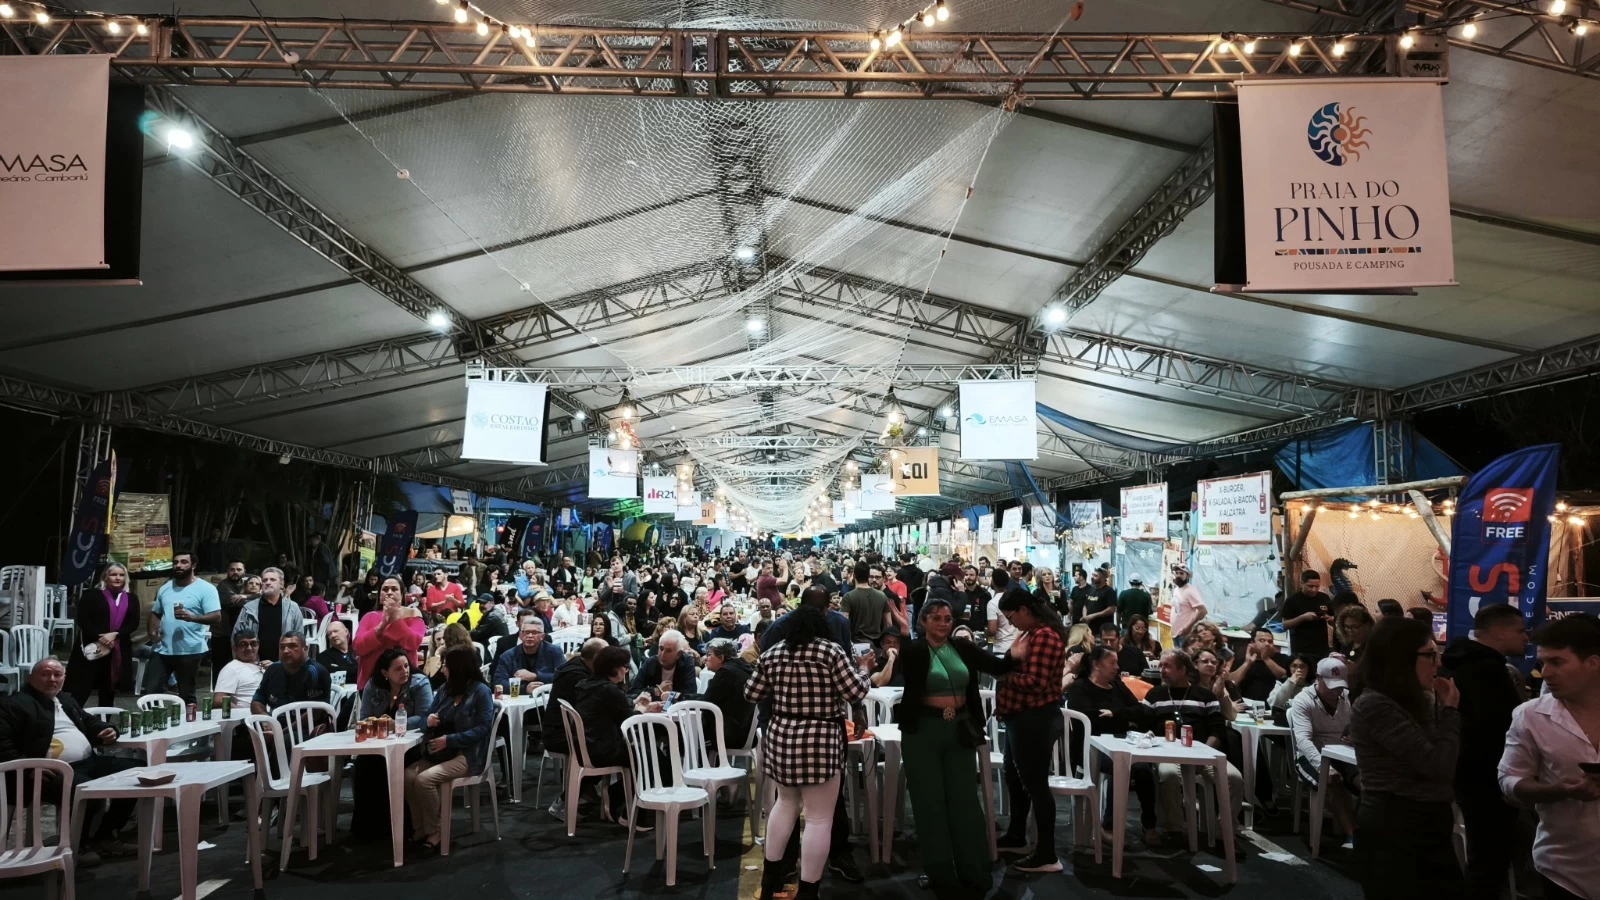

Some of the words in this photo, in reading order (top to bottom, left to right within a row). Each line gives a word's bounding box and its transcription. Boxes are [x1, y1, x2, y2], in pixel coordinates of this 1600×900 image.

[0, 153, 88, 172] MASA
[1290, 181, 1358, 200] PRAIA
[1365, 180, 1400, 199] DO
[1274, 204, 1420, 242] PINHO
[1293, 261, 1343, 271] POUSADA
[1346, 261, 1353, 270] E
[1355, 260, 1405, 270] CAMPING
[1485, 526, 1525, 539] FREE
